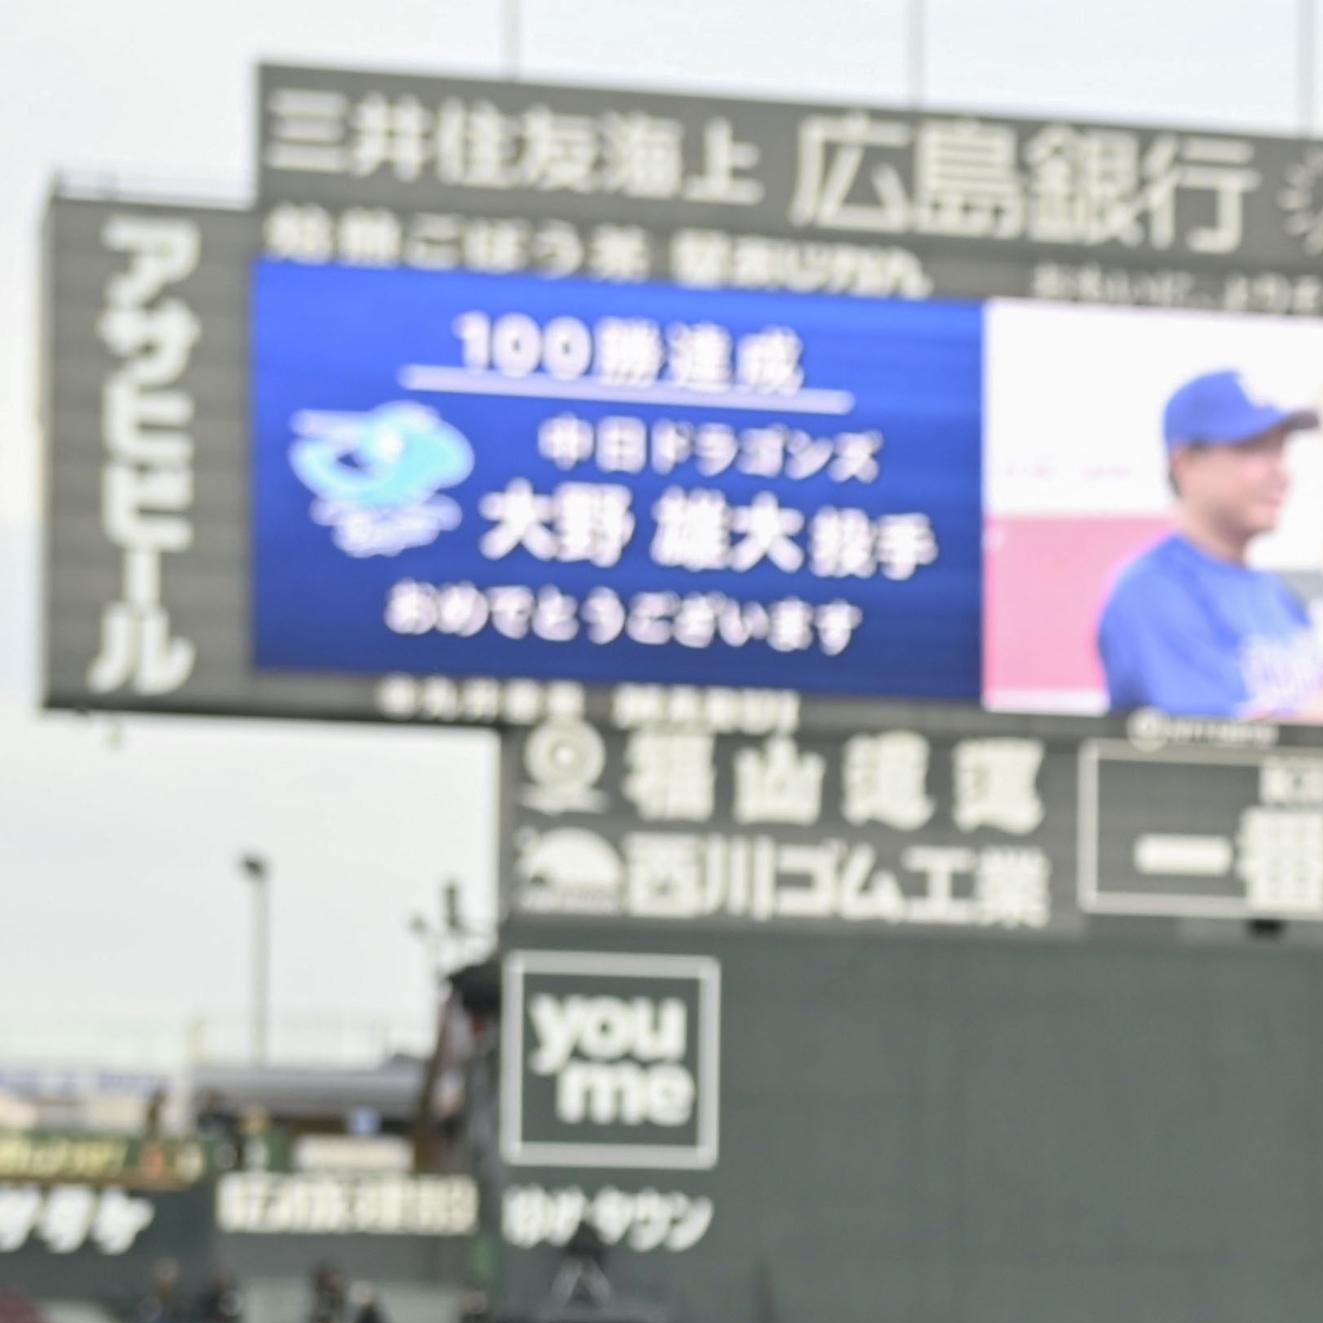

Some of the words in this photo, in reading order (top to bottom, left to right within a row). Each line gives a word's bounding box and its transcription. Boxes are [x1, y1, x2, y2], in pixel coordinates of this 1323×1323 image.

[267, 88, 763, 204] 三井住友海上
[790, 110, 1260, 254] 広島銀行
[454, 311, 804, 394] 100勝達成
[88, 213, 202, 695] アサヒビール
[540, 414, 884, 484] 中日ドラゴンズ
[385, 580, 862, 656] おめでとうございます
[622, 726, 1045, 834] 福山通運
[624, 831, 1051, 927] 西川ゴム工業
[528, 993, 689, 1076] you
[554, 1058, 696, 1126] me
[504, 1184, 713, 1251] ゆめタウン
